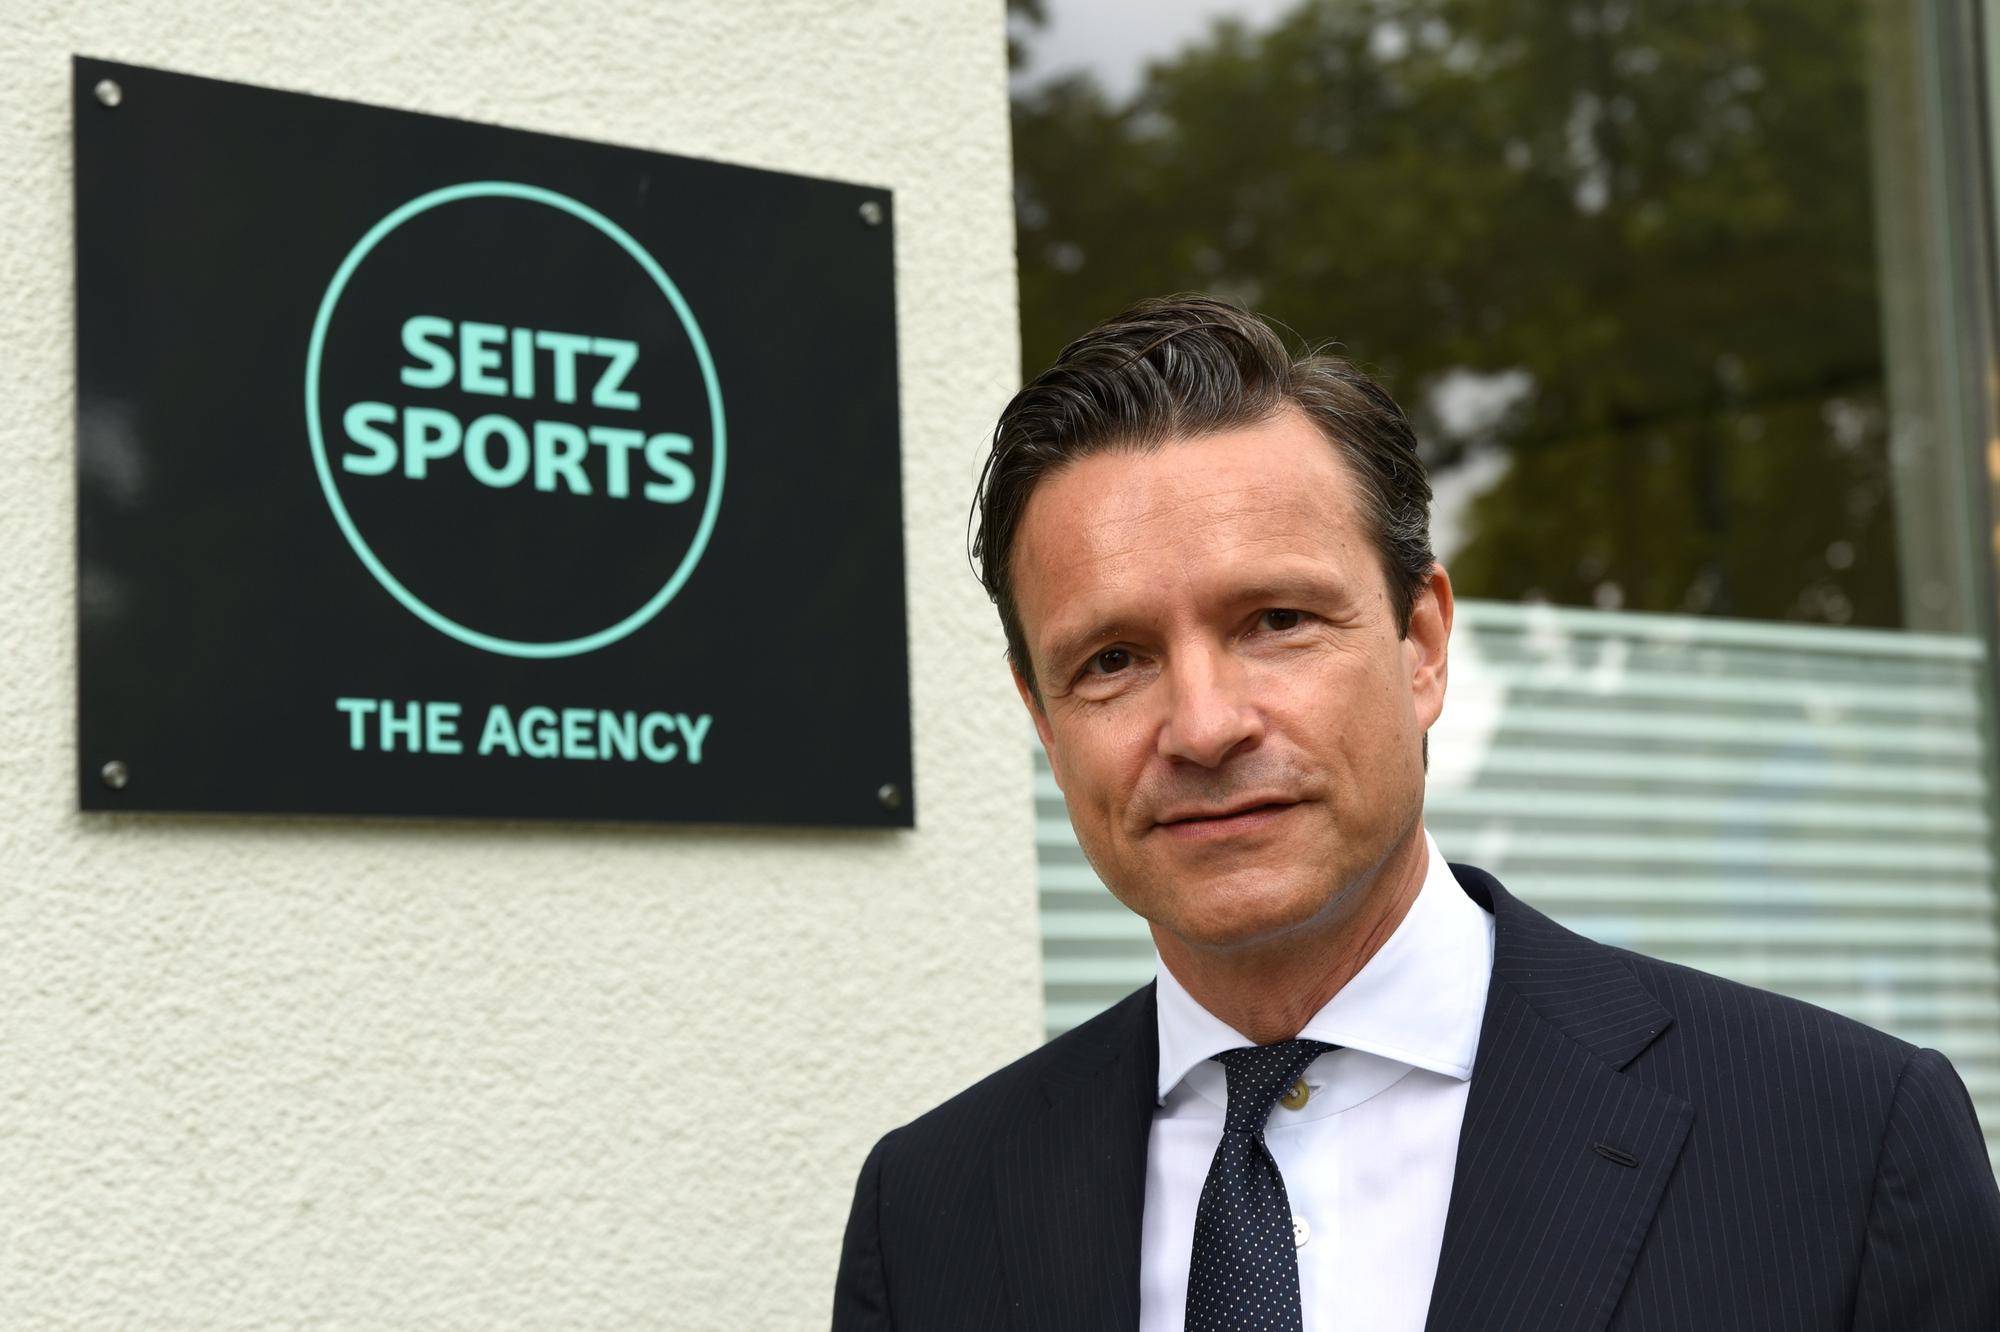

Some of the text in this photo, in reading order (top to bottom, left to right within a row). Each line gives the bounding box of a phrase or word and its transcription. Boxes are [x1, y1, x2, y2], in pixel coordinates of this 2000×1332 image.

[400, 315, 641, 411] SEITZ
[342, 401, 696, 504] SPORTS
[336, 697, 712, 764] THE AGENCY
